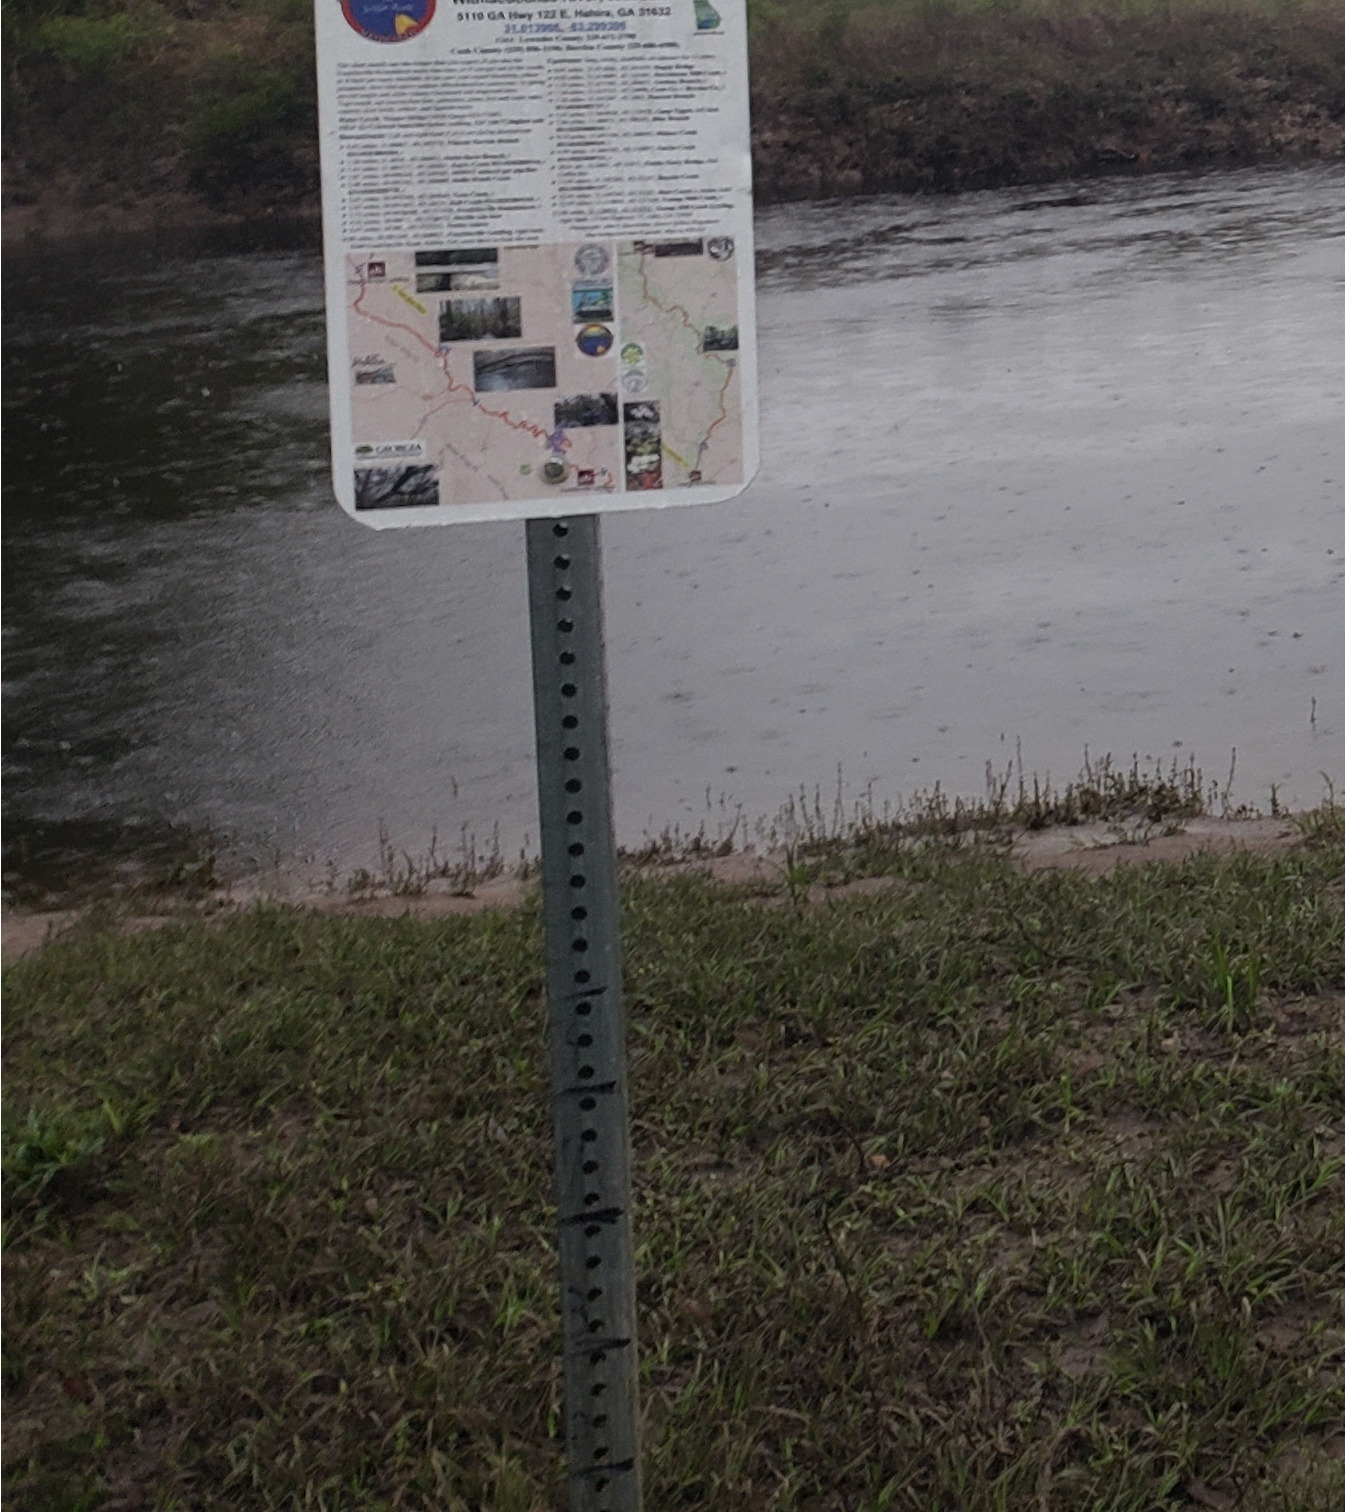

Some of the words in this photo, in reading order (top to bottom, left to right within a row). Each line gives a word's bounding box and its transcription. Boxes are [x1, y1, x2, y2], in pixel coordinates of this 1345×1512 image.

[487, 11, 506, 21] GA
[508, 10, 533, 23] Hwy
[617, 7, 635, 18] GA
